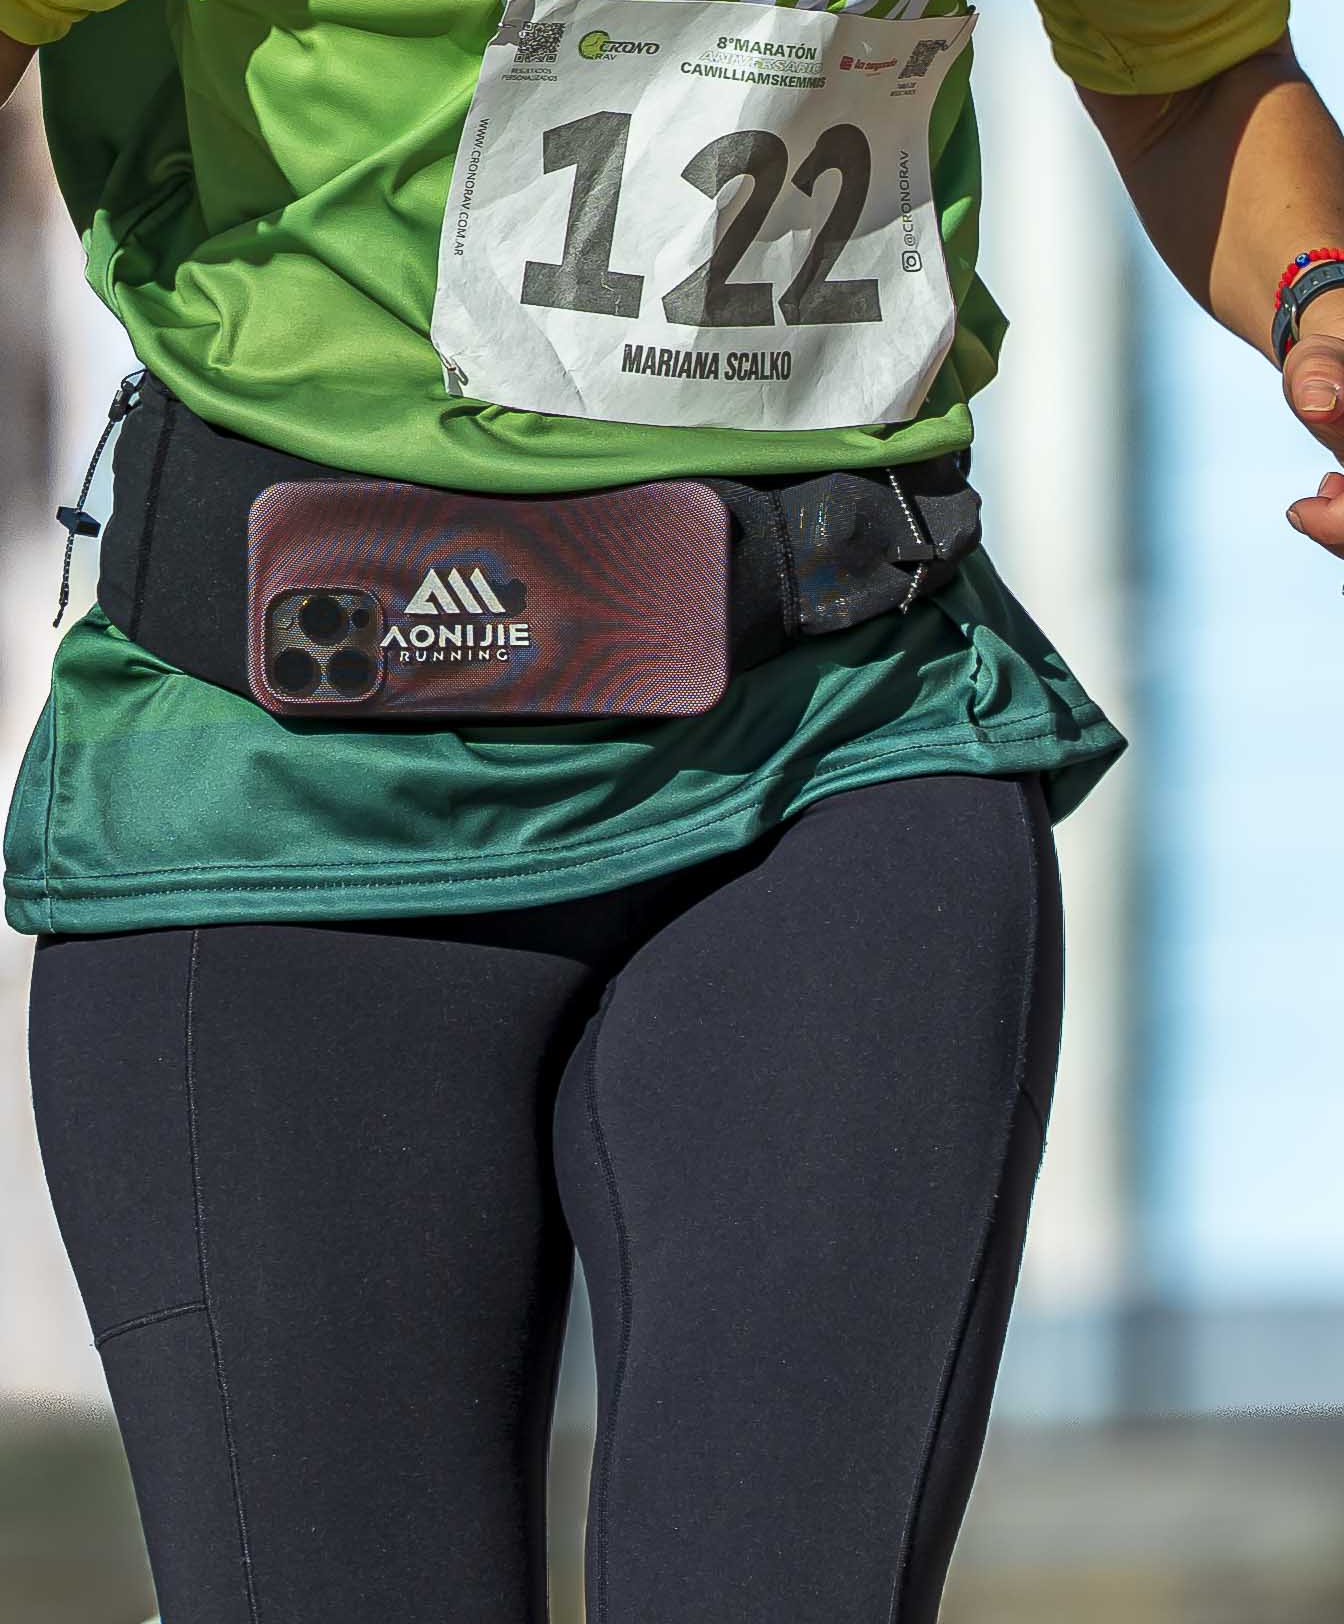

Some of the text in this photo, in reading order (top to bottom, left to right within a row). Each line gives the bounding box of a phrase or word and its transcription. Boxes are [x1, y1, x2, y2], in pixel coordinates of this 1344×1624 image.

[681, 61, 826, 89] CAWILLIAMSKEMMIS
[454, 118, 490, 256] WWW.CRONORAV.COM.AR
[899, 150, 916, 247] @CRONORAV
[520, 110, 883, 327] 122
[621, 343, 792, 381] MARIANA SCALKO
[380, 624, 530, 647] AONIJIE
[399, 649, 508, 662] RUNNING
